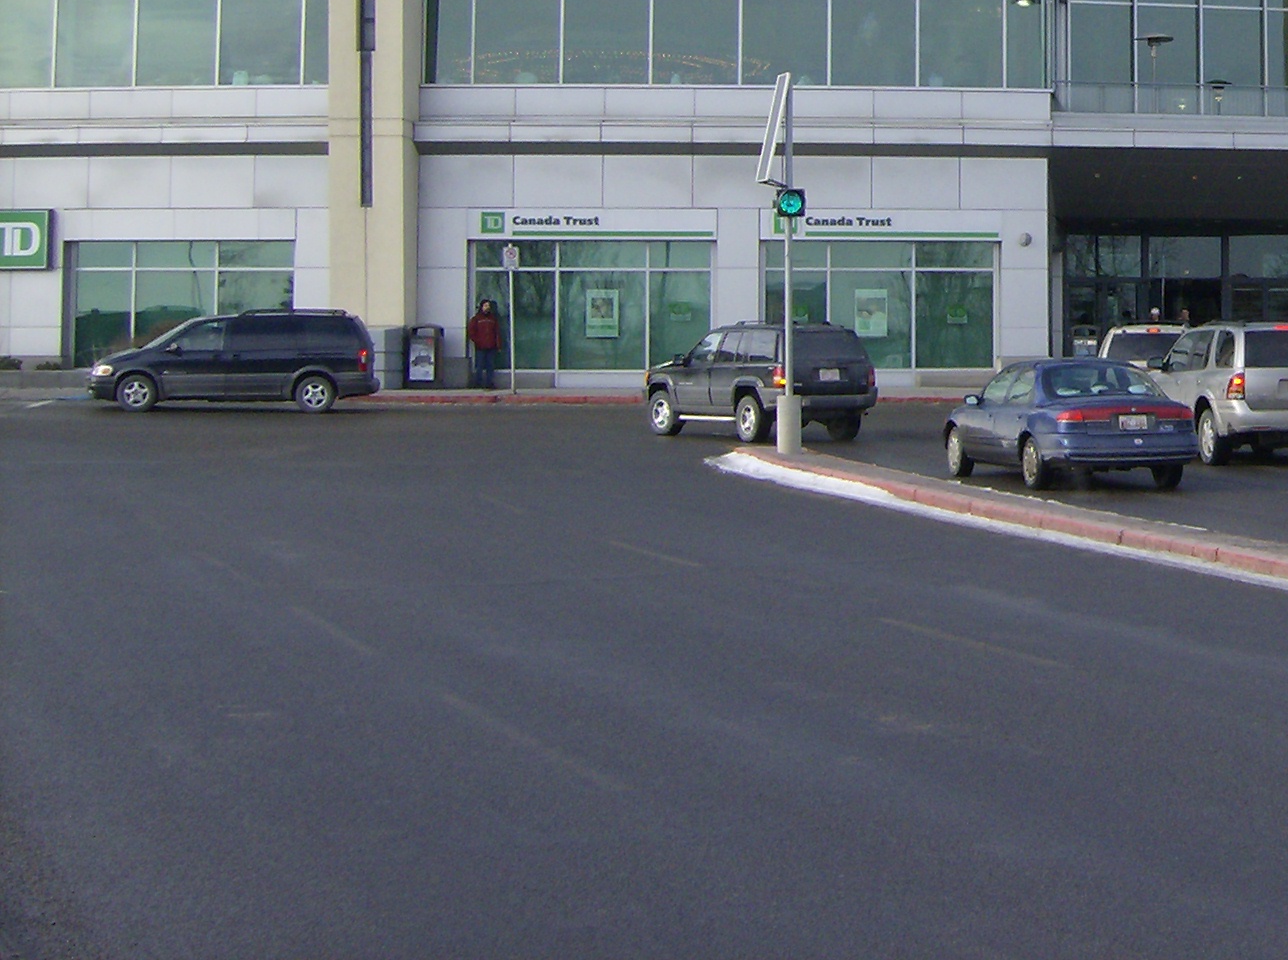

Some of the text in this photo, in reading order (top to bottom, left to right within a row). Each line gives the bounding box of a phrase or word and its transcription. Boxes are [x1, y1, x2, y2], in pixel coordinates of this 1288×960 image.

[484, 215, 600, 230] TD Canada Trust
[805, 216, 853, 227] Canada
[856, 216, 892, 227] Trust
[0, 222, 40, 256] TD
